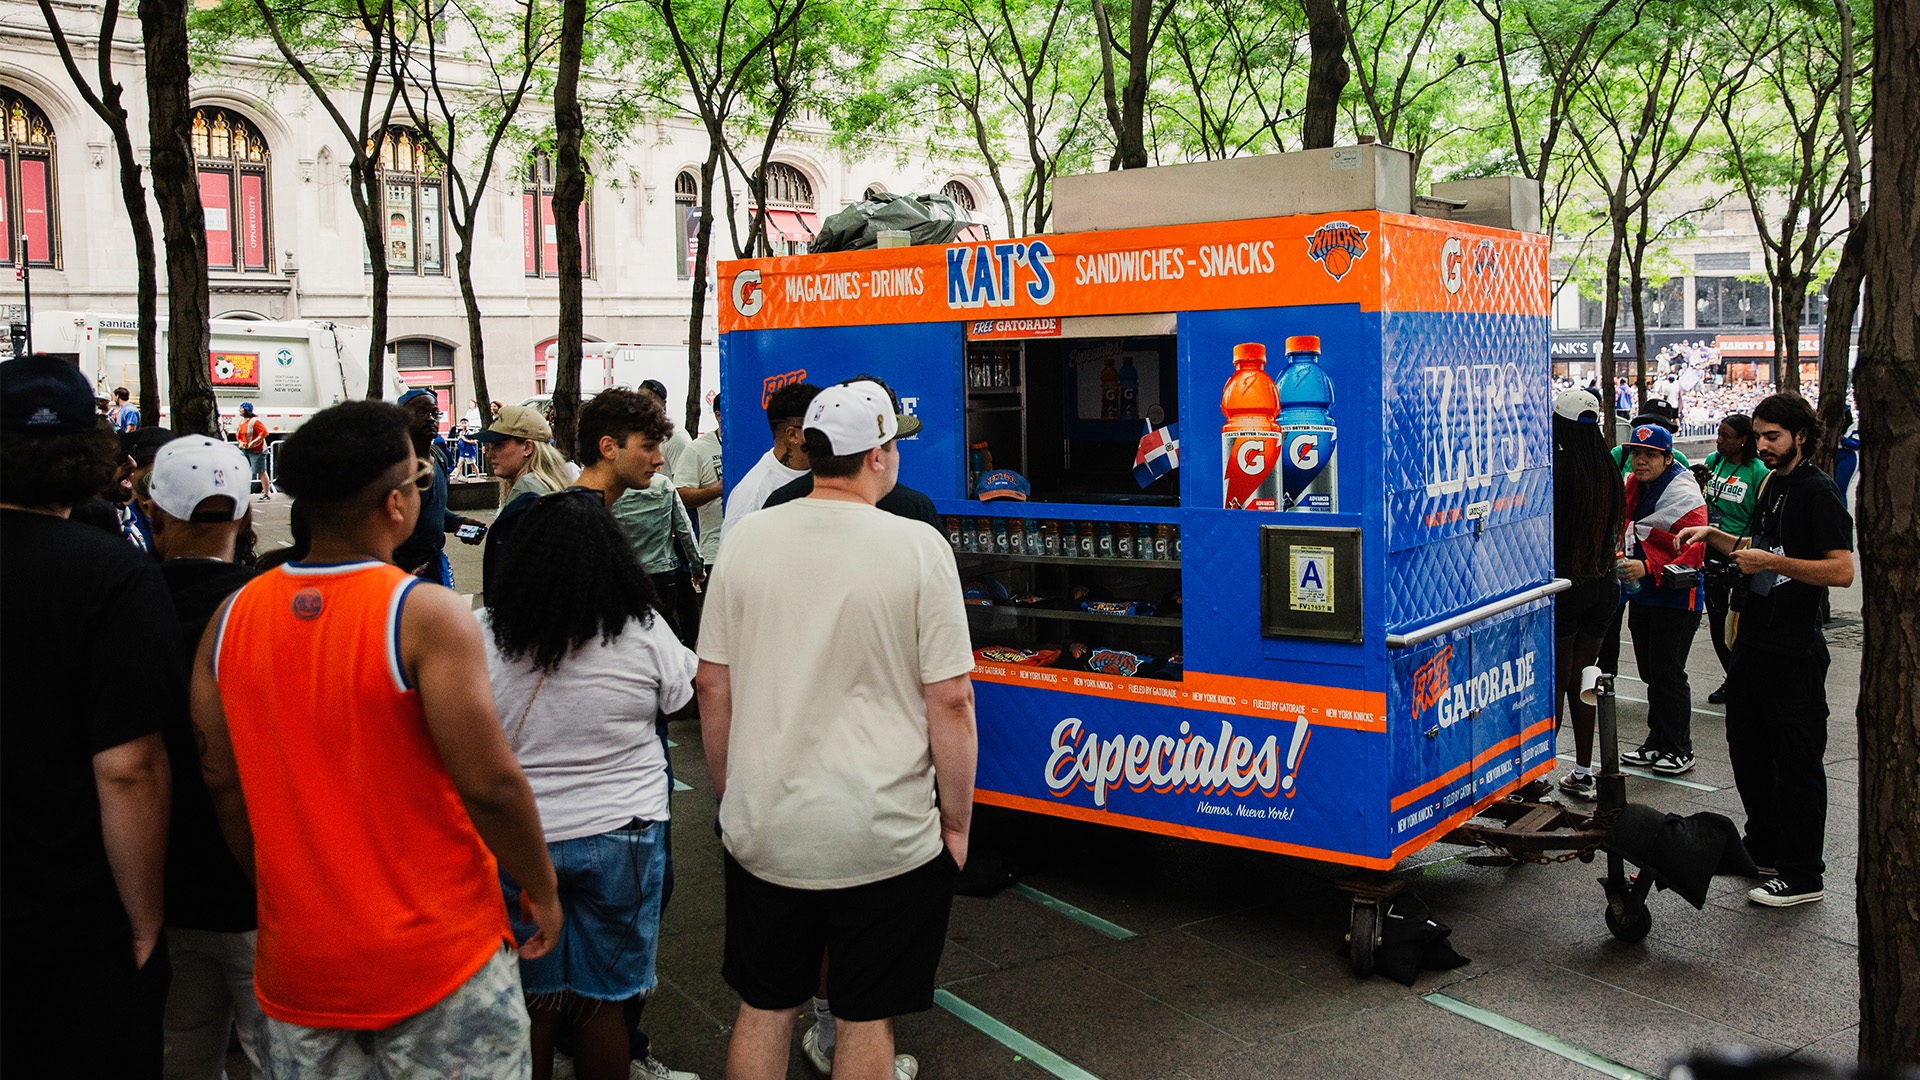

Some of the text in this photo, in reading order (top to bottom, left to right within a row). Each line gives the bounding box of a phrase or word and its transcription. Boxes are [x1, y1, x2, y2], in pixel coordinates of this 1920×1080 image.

[248, 195, 256, 248] OPPORTUNITY
[1309, 226, 1366, 255] KNICKS
[1441, 237, 1462, 295] G
[946, 240, 1055, 310] KAT'S
[731, 269, 763, 317] G
[100, 320, 140, 329] sanitati
[973, 318, 1056, 336] FREE GATORADE
[1551, 342, 1630, 354] ANK'S PIZA
[1720, 341, 1764, 351] HARRY'S
[1106, 389, 1115, 400] G
[1124, 388, 1134, 400] G
[1237, 440, 1265, 476] G
[1290, 434, 1318, 470] G
[986, 472, 1017, 486] NEW YORK
[950, 533, 959, 544] G
[979, 534, 987, 544] G
[997, 534, 1006, 546] G
[1011, 534, 1018, 546] G
[1046, 536, 1053, 548] G
[1081, 538, 1090, 550] G
[1100, 538, 1109, 549] G
[1118, 539, 1128, 551] G
[1155, 540, 1164, 552] G
[1300, 560, 1322, 588] A
[1412, 645, 1452, 720] FREE
[1438, 651, 1535, 728] GATORADE
[985, 666, 1006, 676] GATORADE
[1020, 670, 1029, 679] NEW
[1030, 672, 1040, 680] YORK
[1041, 673, 1058, 683] KNICKS
[1073, 677, 1083, 686] NEW
[1084, 678, 1096, 688] YORK
[1096, 680, 1113, 690] KNICKS
[1128, 684, 1146, 694] FUELED
[1146, 686, 1152, 695] BY
[1152, 687, 1177, 698] GATORADE
[1192, 692, 1203, 701] NEW
[1203, 693, 1217, 704] YORK
[1218, 694, 1236, 706] KNICKS
[1253, 699, 1271, 710] FUELED
[1271, 701, 1279, 711] BY
[1279, 702, 1306, 714] GATORADE
[1326, 708, 1338, 718] NEW
[1338, 710, 1353, 720] YORK
[1354, 711, 1374, 722] KNICKS
[1044, 715, 1310, 808] Especiales!
[1398, 816, 1407, 834] NEW
[1407, 811, 1418, 828] YORK
[1418, 804, 1434, 822] KNICKS
[1493, 766, 1501, 780] YORK
[1501, 759, 1512, 775] KNICKS
[1236, 804, 1266, 818] Nueva
[1268, 807, 1294, 820] York!
